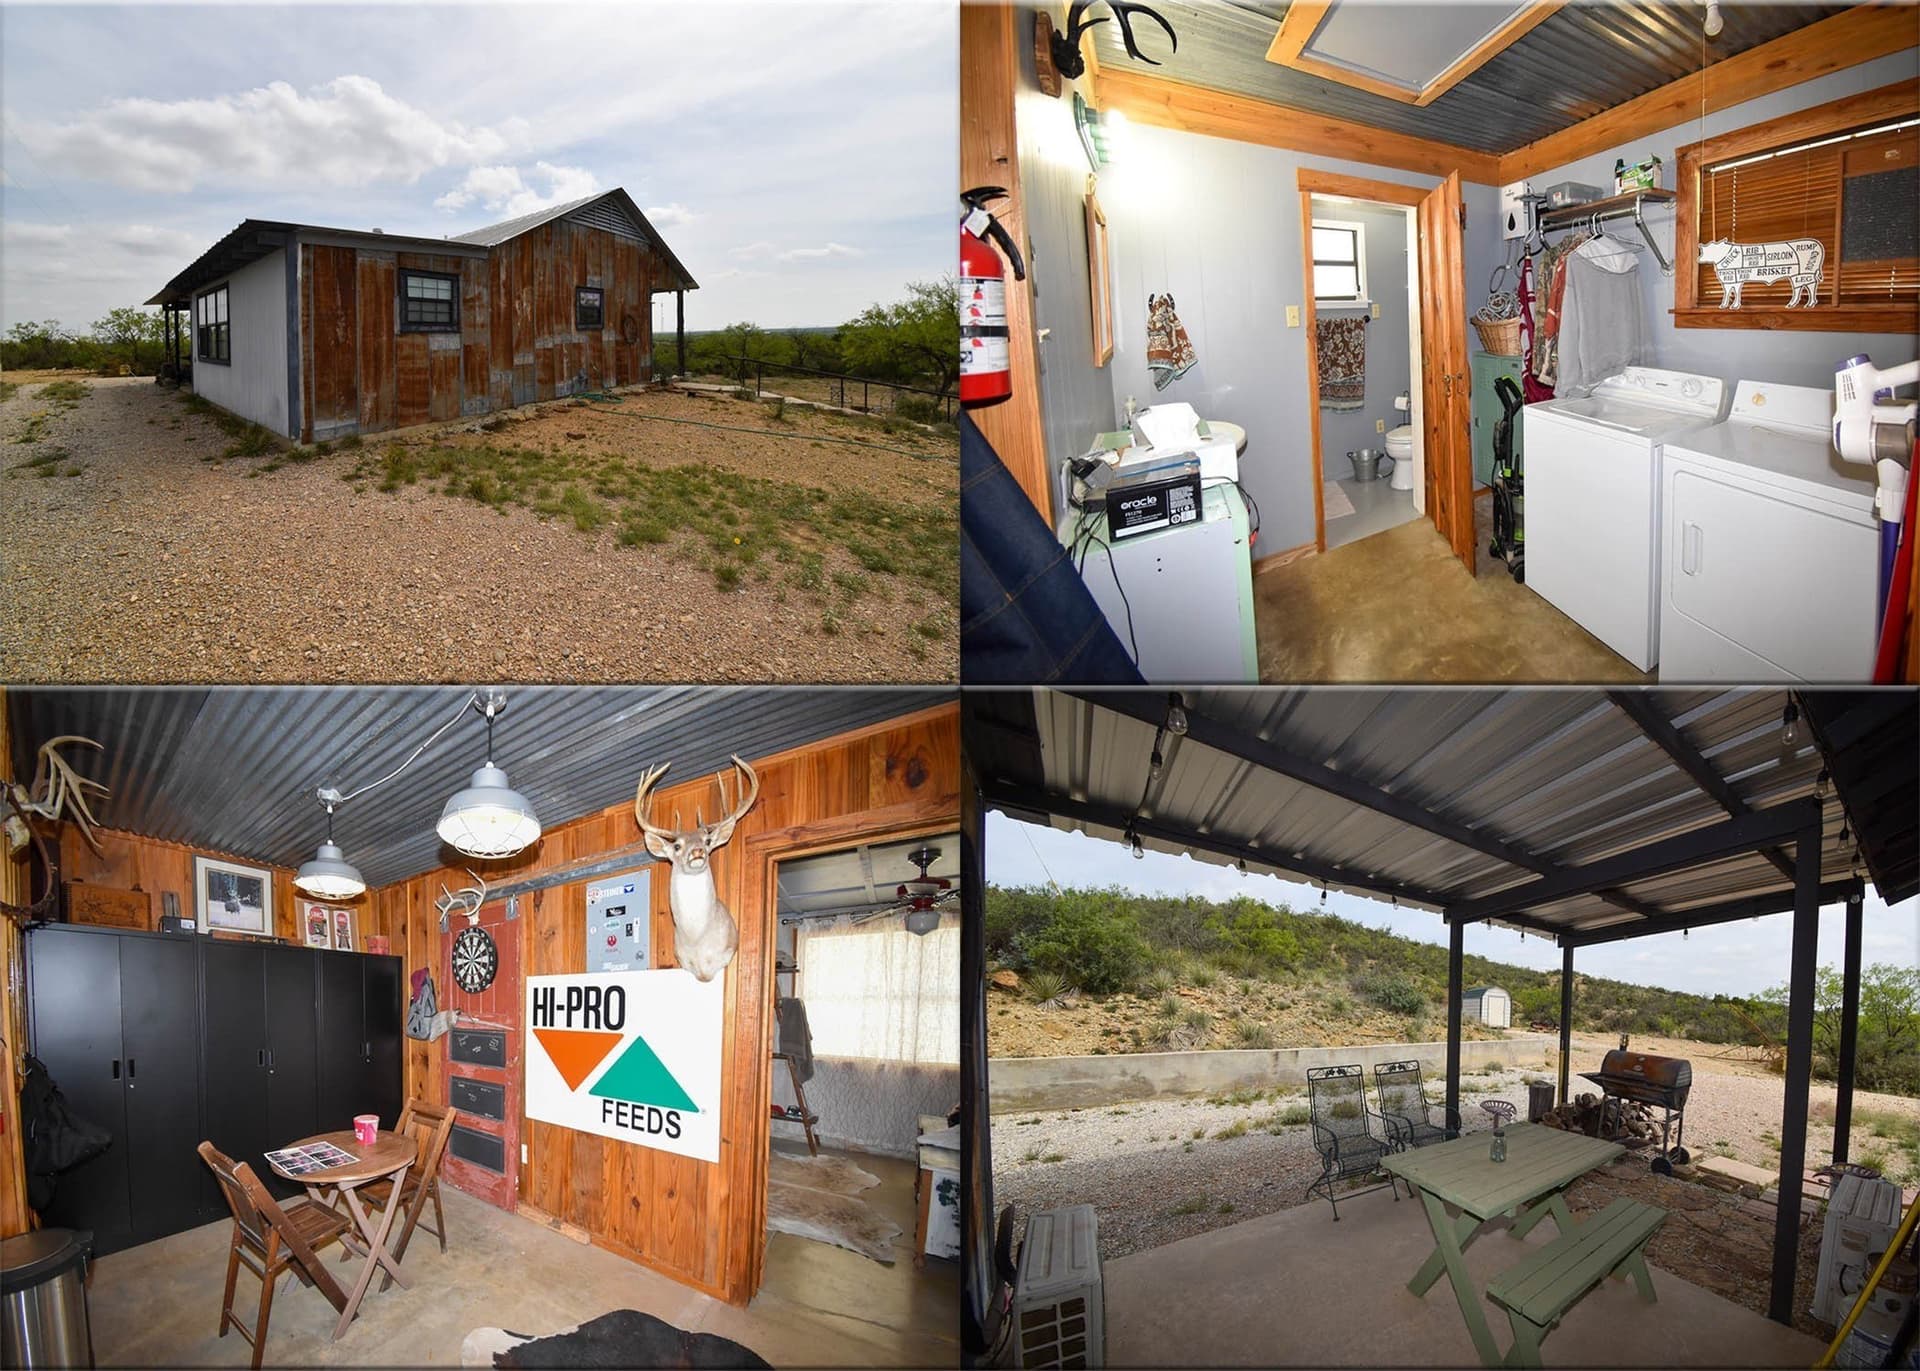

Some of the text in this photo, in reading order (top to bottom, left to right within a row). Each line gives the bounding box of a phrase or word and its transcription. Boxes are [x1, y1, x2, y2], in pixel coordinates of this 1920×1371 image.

[1796, 243, 1817, 252] RUMP
[1720, 248, 1740, 269] CHUCK
[1767, 251, 1793, 261] SIRLOIN
[1756, 267, 1792, 277] BRISKET
[1121, 496, 1157, 510] oracle
[532, 985, 626, 1031] HI-PRO
[602, 1099, 681, 1139] FEEDS
